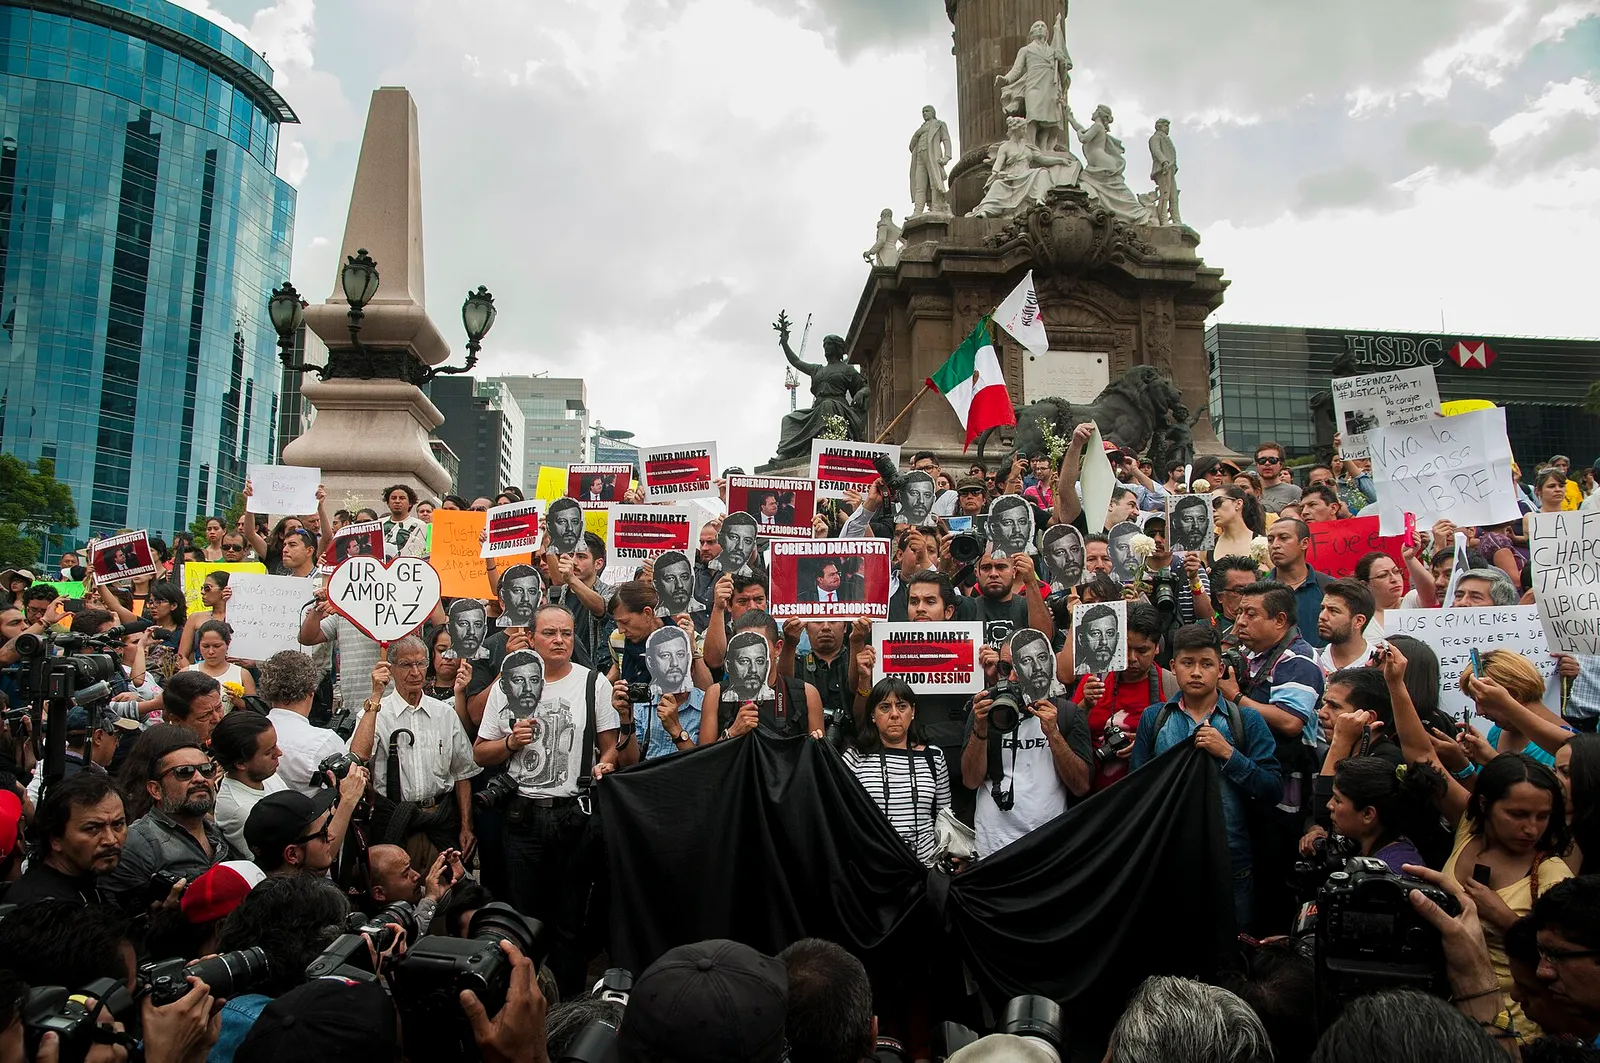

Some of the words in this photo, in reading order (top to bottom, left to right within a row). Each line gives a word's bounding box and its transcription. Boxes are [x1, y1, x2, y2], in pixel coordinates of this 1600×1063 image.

[1345, 334, 1444, 368] HSBC
[1356, 374, 1400, 387] ESPINOZA
[1338, 387, 1387, 400] #JUSTICIA
[1389, 382, 1409, 391] PARA
[1410, 380, 1422, 388] TI
[1396, 394, 1420, 406] coraje
[1424, 399, 1434, 409] el
[823, 447, 853, 458] JAVIER
[1371, 436, 1424, 468] Viva
[1429, 425, 1458, 445] la
[648, 452, 673, 463] JAVIER
[674, 449, 707, 460] DUARTE
[1391, 445, 1472, 493] Prensa
[650, 484, 678, 495] ESTADO
[679, 481, 710, 493] ASESINO
[731, 477, 769, 489] GOBIERNO
[769, 480, 813, 491] DUARTISTA
[819, 480, 850, 492] ESTADO
[851, 483, 873, 494] ASES
[512, 506, 536, 518] DUARTE
[618, 512, 648, 524] JAVIER
[649, 513, 687, 525] DUARTE
[767, 525, 812, 536] PERIODISTAS
[1534, 514, 1568, 540] LA
[490, 541, 511, 551] ESTADO
[512, 537, 536, 548] ASESINO
[774, 542, 826, 555] GOBIERNO
[827, 541, 887, 555] DUARTISTA
[617, 548, 648, 559] ESTADO
[341, 582, 397, 602] AMOR
[375, 603, 420, 626] PAZ
[771, 603, 813, 616] ASESINO
[813, 603, 826, 615] DE
[826, 603, 888, 616] PERIODISTAS
[1399, 616, 1427, 634] LOS
[1434, 613, 1518, 630] CRIMENES
[887, 631, 925, 644] JAVIER
[926, 631, 971, 644] DUARTE
[1558, 637, 1580, 652] LA
[926, 672, 971, 684] ASESINO
